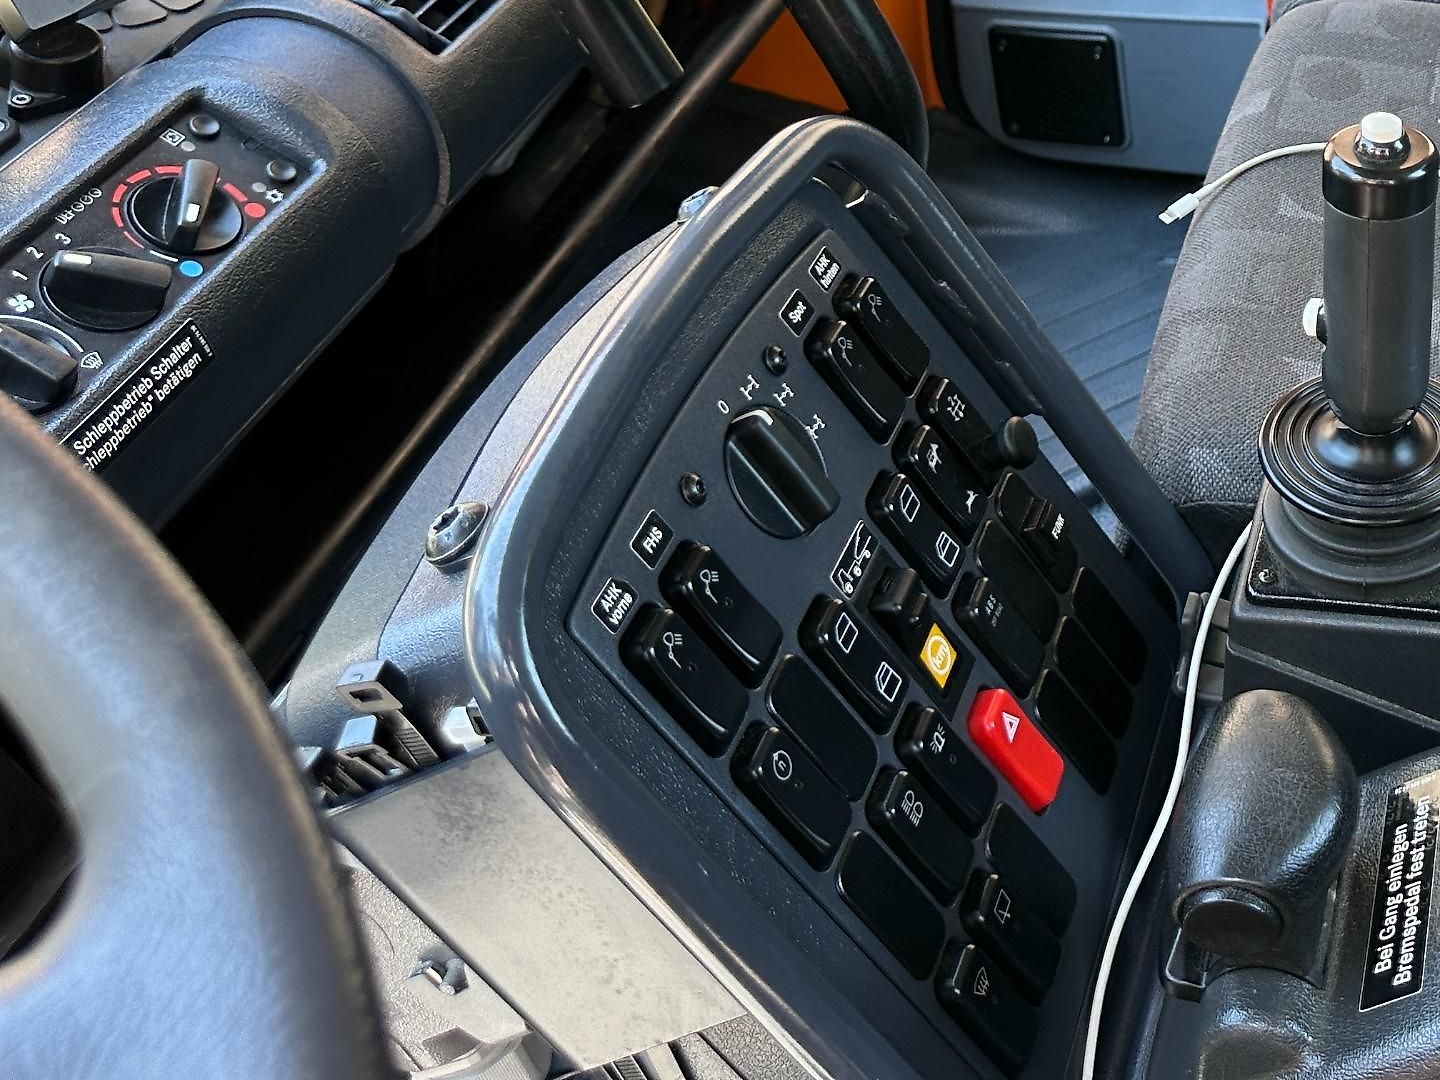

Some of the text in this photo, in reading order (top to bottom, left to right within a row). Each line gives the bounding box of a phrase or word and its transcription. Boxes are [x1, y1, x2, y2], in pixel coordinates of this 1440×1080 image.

[26, 246, 44, 259] 2
[55, 233, 72, 245] 3
[12, 270, 28, 281] 1
[788, 300, 807, 323] Spot
[154, 352, 202, 402] betätigen
[73, 377, 154, 455] Schleppbetrieb
[150, 336, 193, 381] Schalter
[642, 526, 663, 554] FHS
[1051, 512, 1065, 540] FUNK
[600, 582, 622, 613] AHK
[608, 592, 633, 625] vorne
[1412, 795, 1431, 846] treten
[1406, 844, 1426, 881] fest
[1374, 822, 1409, 975] Bei Gang einlegen
[1392, 880, 1422, 986] Bremspedal
